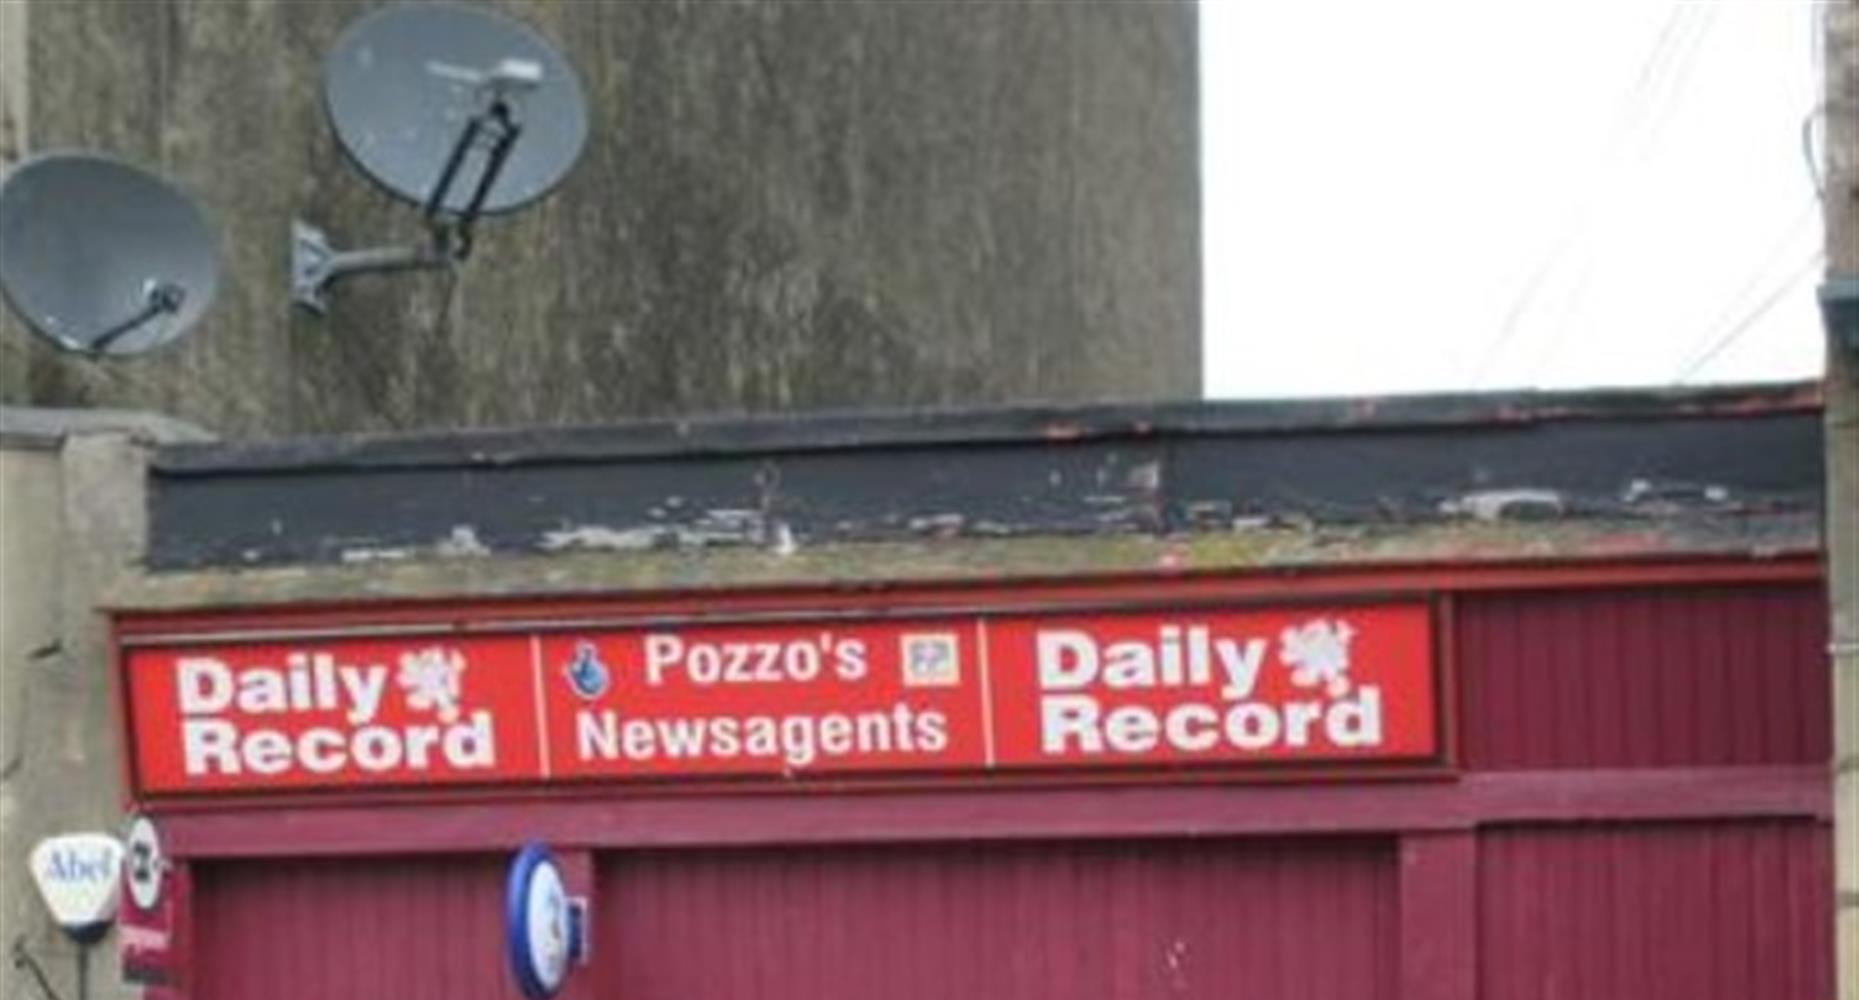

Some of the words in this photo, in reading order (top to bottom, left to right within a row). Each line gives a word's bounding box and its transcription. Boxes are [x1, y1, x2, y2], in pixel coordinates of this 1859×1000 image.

[174, 653, 387, 724] Daily
[644, 633, 868, 686] Pozzo's
[1035, 625, 1267, 698] Daily
[182, 710, 496, 776] Record
[575, 701, 948, 766] Newsagents
[1040, 686, 1383, 754] Record
